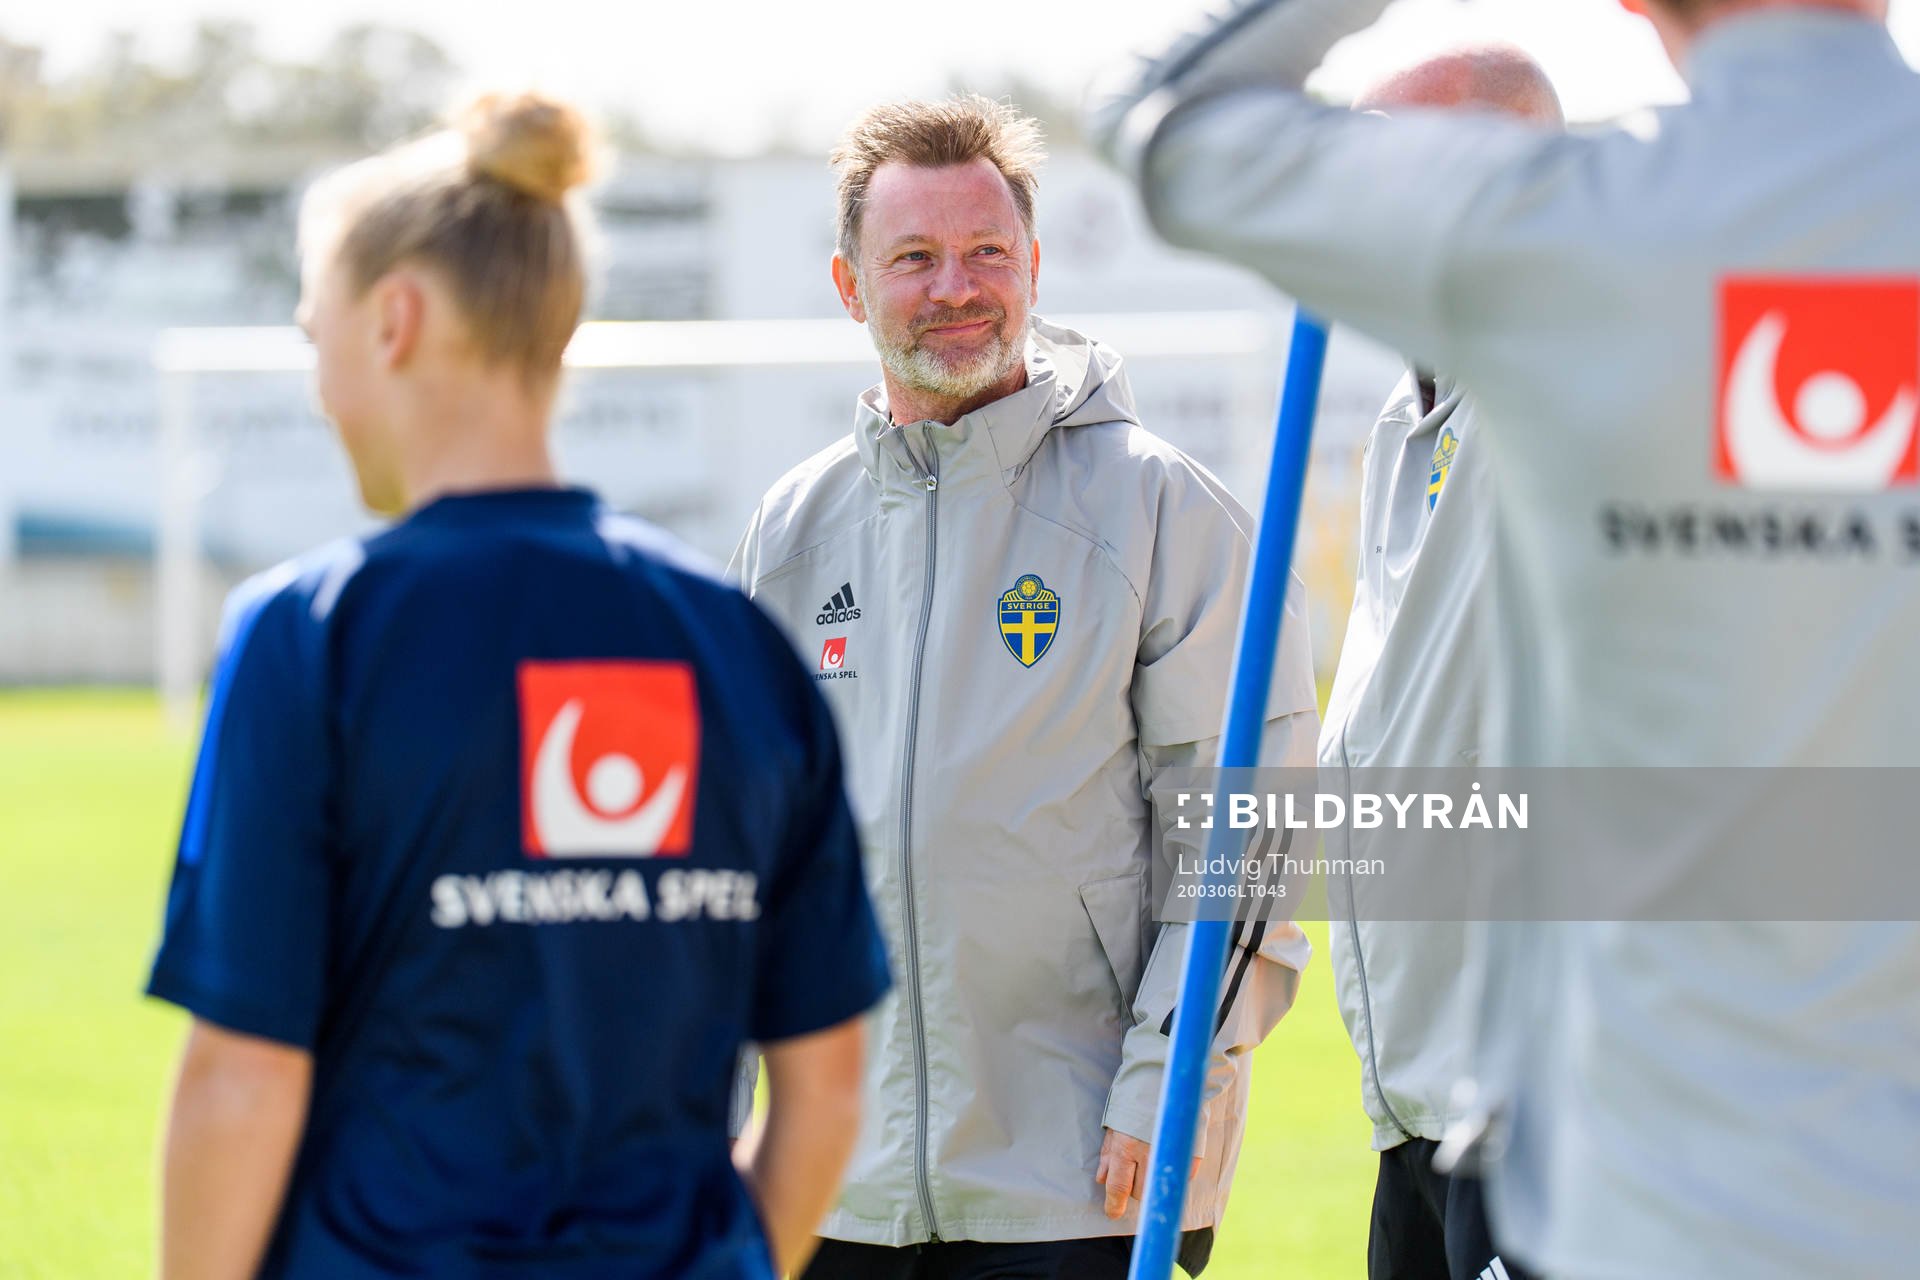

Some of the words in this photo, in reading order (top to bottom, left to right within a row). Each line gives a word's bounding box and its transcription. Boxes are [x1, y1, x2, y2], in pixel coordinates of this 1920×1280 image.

[1007, 602, 1050, 610] SVERIGE
[816, 608, 861, 625] adidas
[815, 672, 837, 681] ENSKA
[839, 670, 858, 679] SPEL
[430, 869, 650, 928] SVENSKA
[655, 868, 761, 922] SPEL
